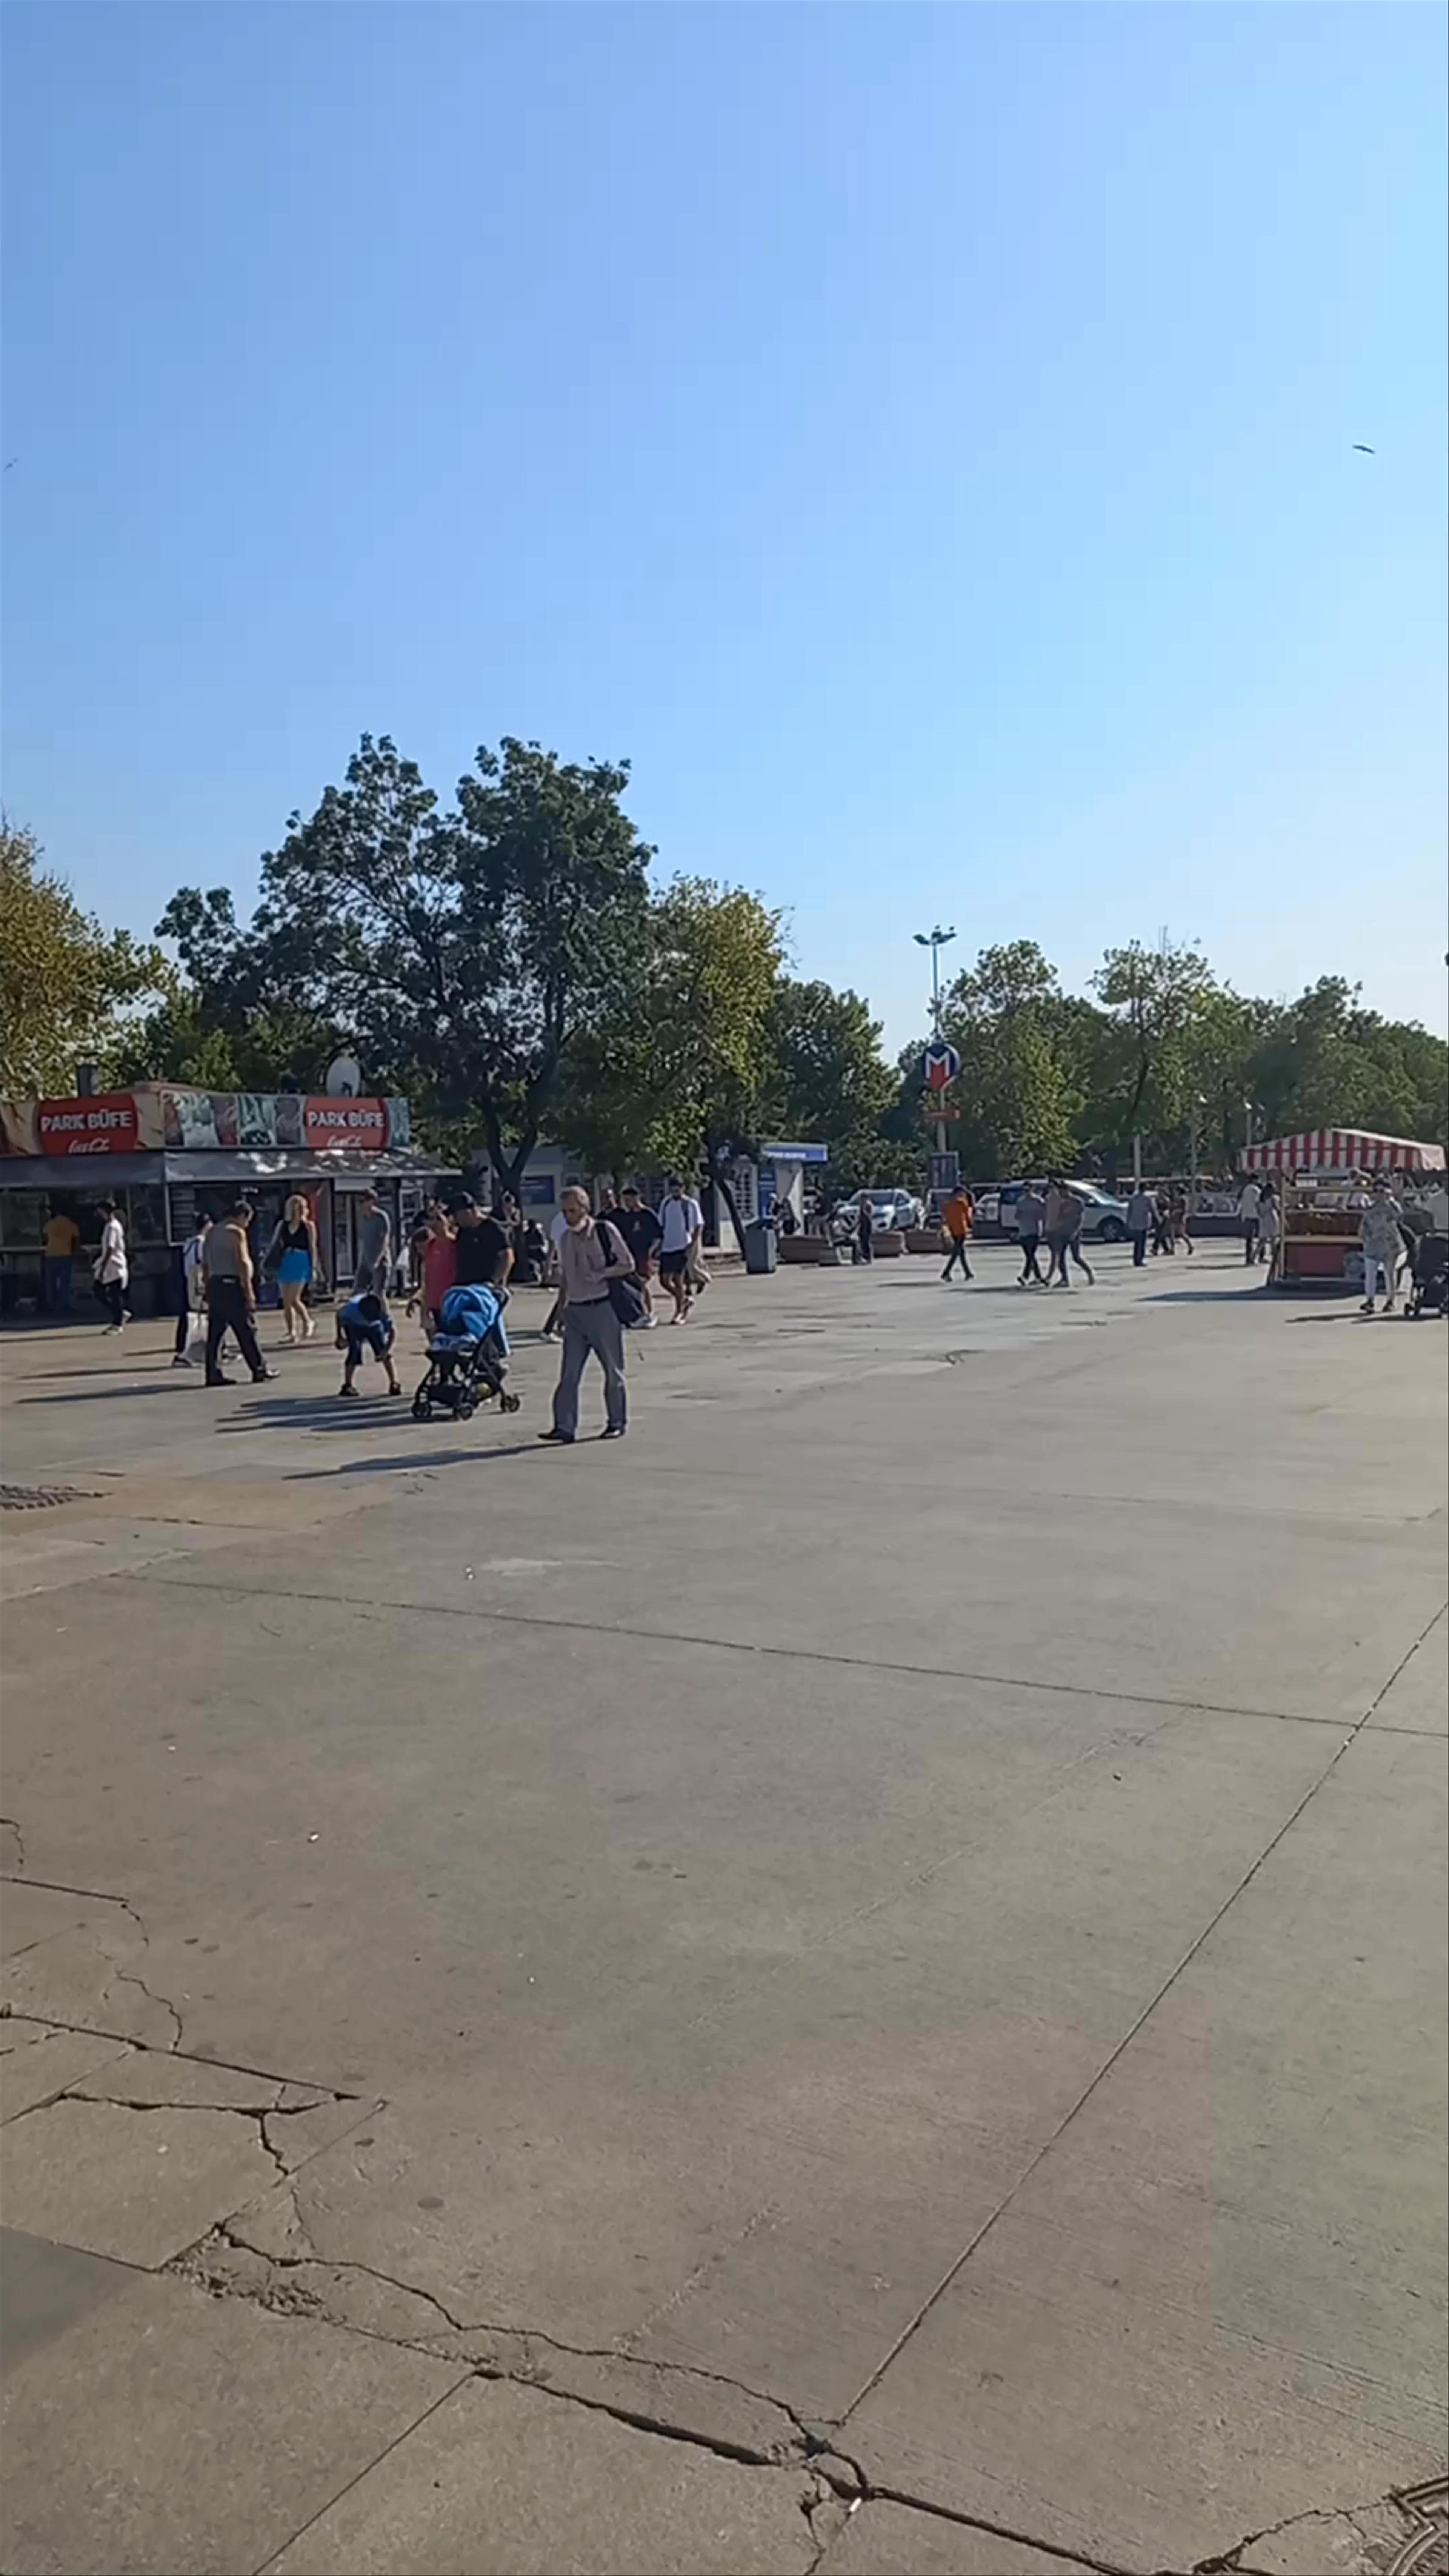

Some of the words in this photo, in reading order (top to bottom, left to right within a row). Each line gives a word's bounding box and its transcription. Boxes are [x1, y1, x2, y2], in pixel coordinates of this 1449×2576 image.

[926, 1051, 950, 1079] M
[40, 1115, 85, 1132] PARK
[88, 1109, 132, 1129] BÜFE
[308, 1111, 347, 1127] PARK
